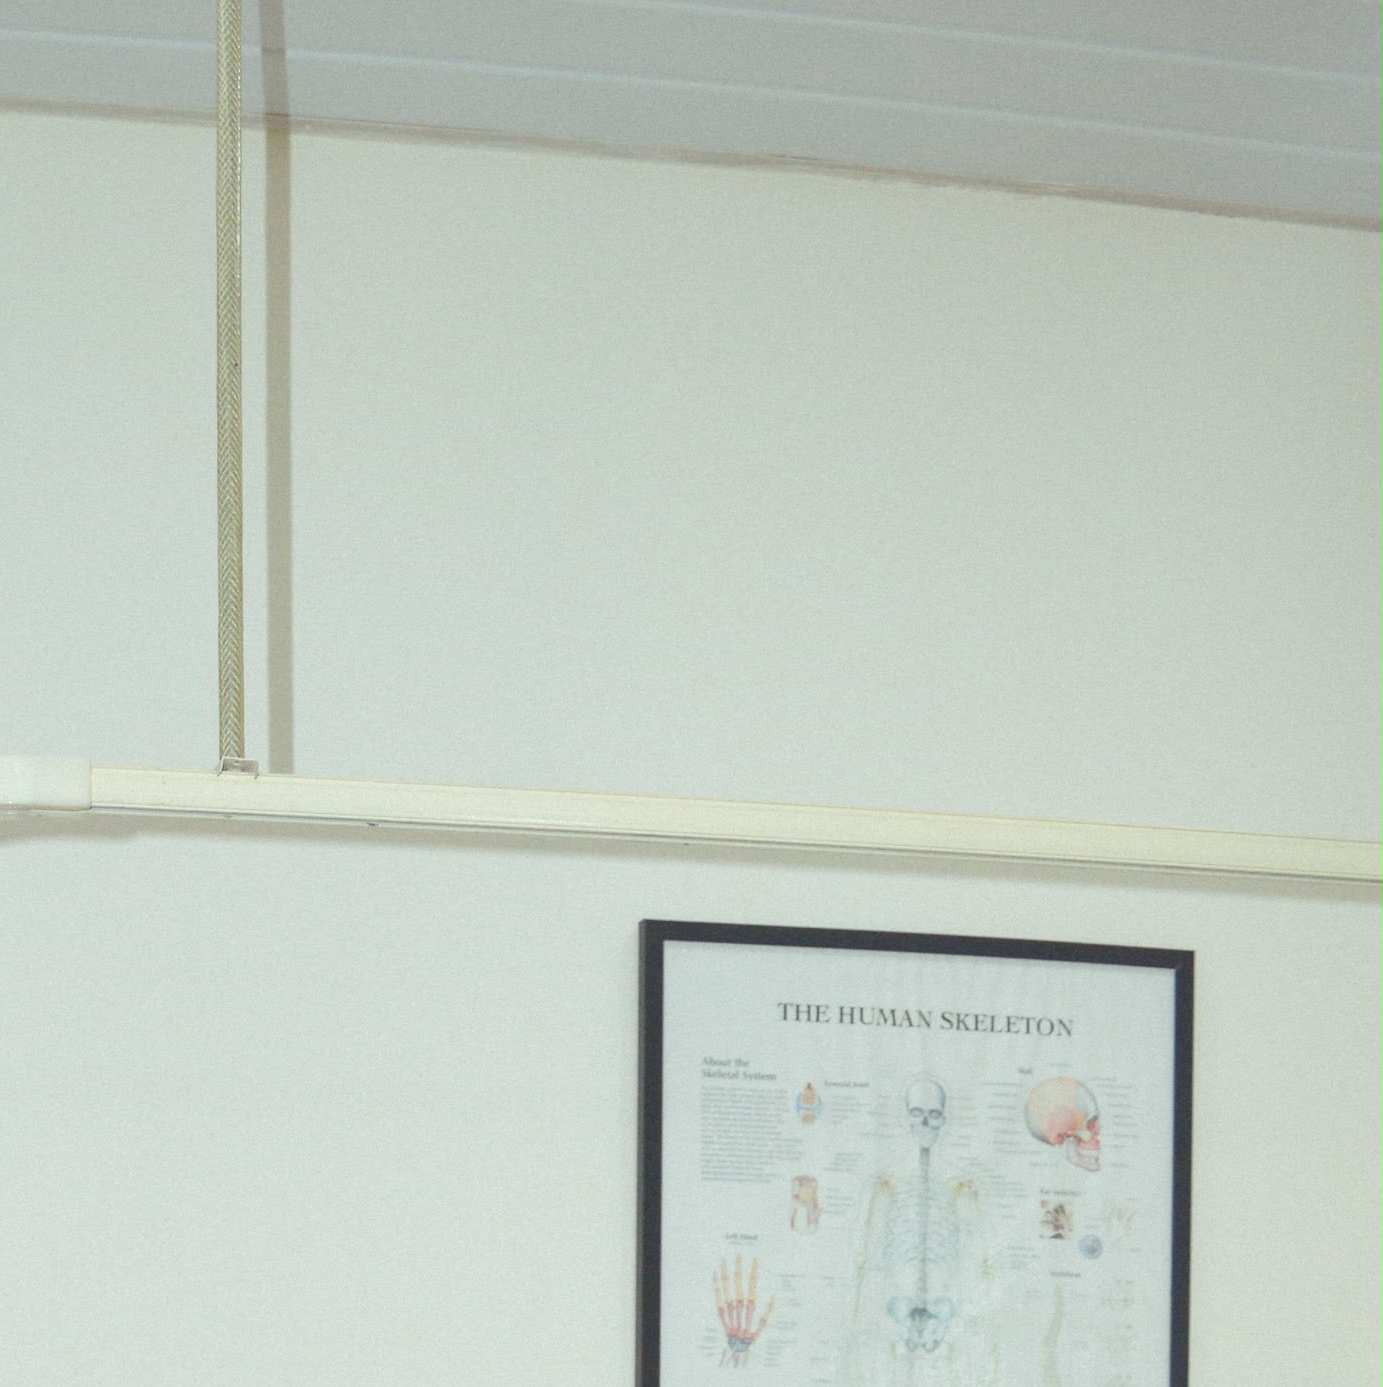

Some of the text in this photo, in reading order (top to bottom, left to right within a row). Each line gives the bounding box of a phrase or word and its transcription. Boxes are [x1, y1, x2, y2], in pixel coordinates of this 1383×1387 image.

[777, 1002, 1074, 1038] THE HUMAN SKELETON
